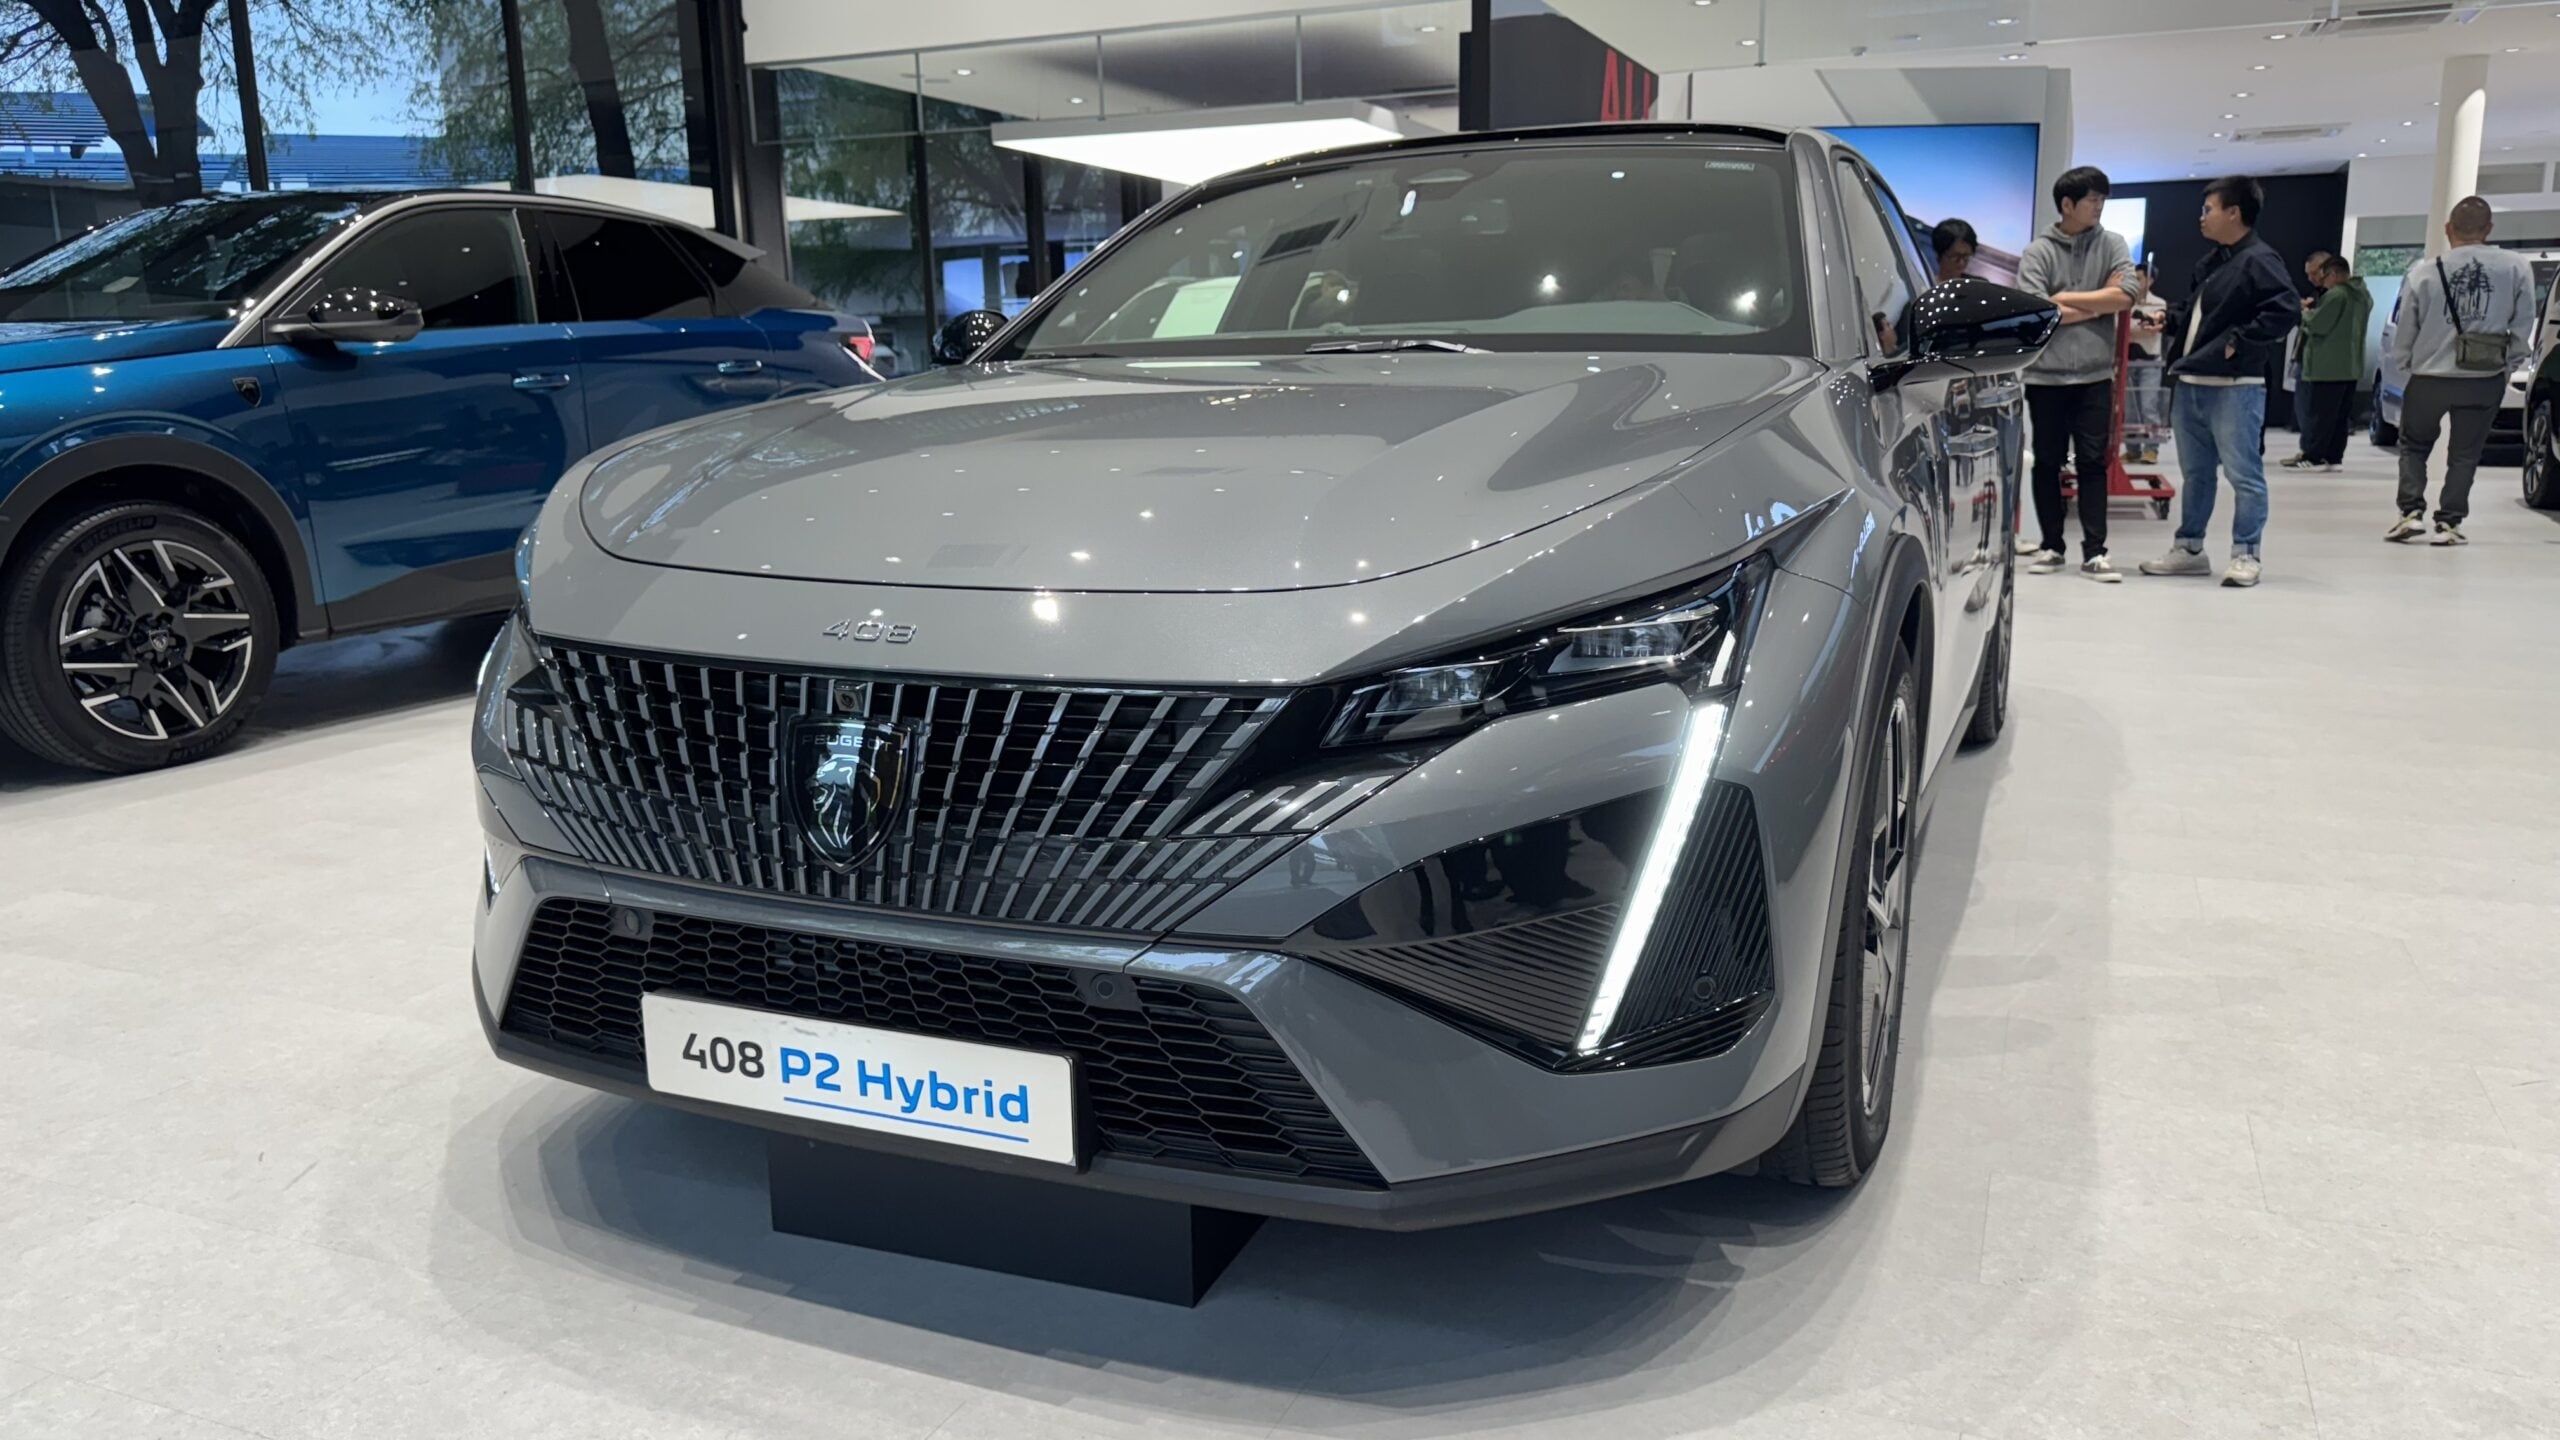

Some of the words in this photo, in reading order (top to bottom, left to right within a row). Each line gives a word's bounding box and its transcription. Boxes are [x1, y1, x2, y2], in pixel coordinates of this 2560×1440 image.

[822, 618, 917, 644] 408
[802, 734, 893, 752] PEUGEOT
[681, 1033, 765, 1079] 408
[780, 1047, 841, 1092] P2
[857, 1060, 1030, 1123] Hybrid
